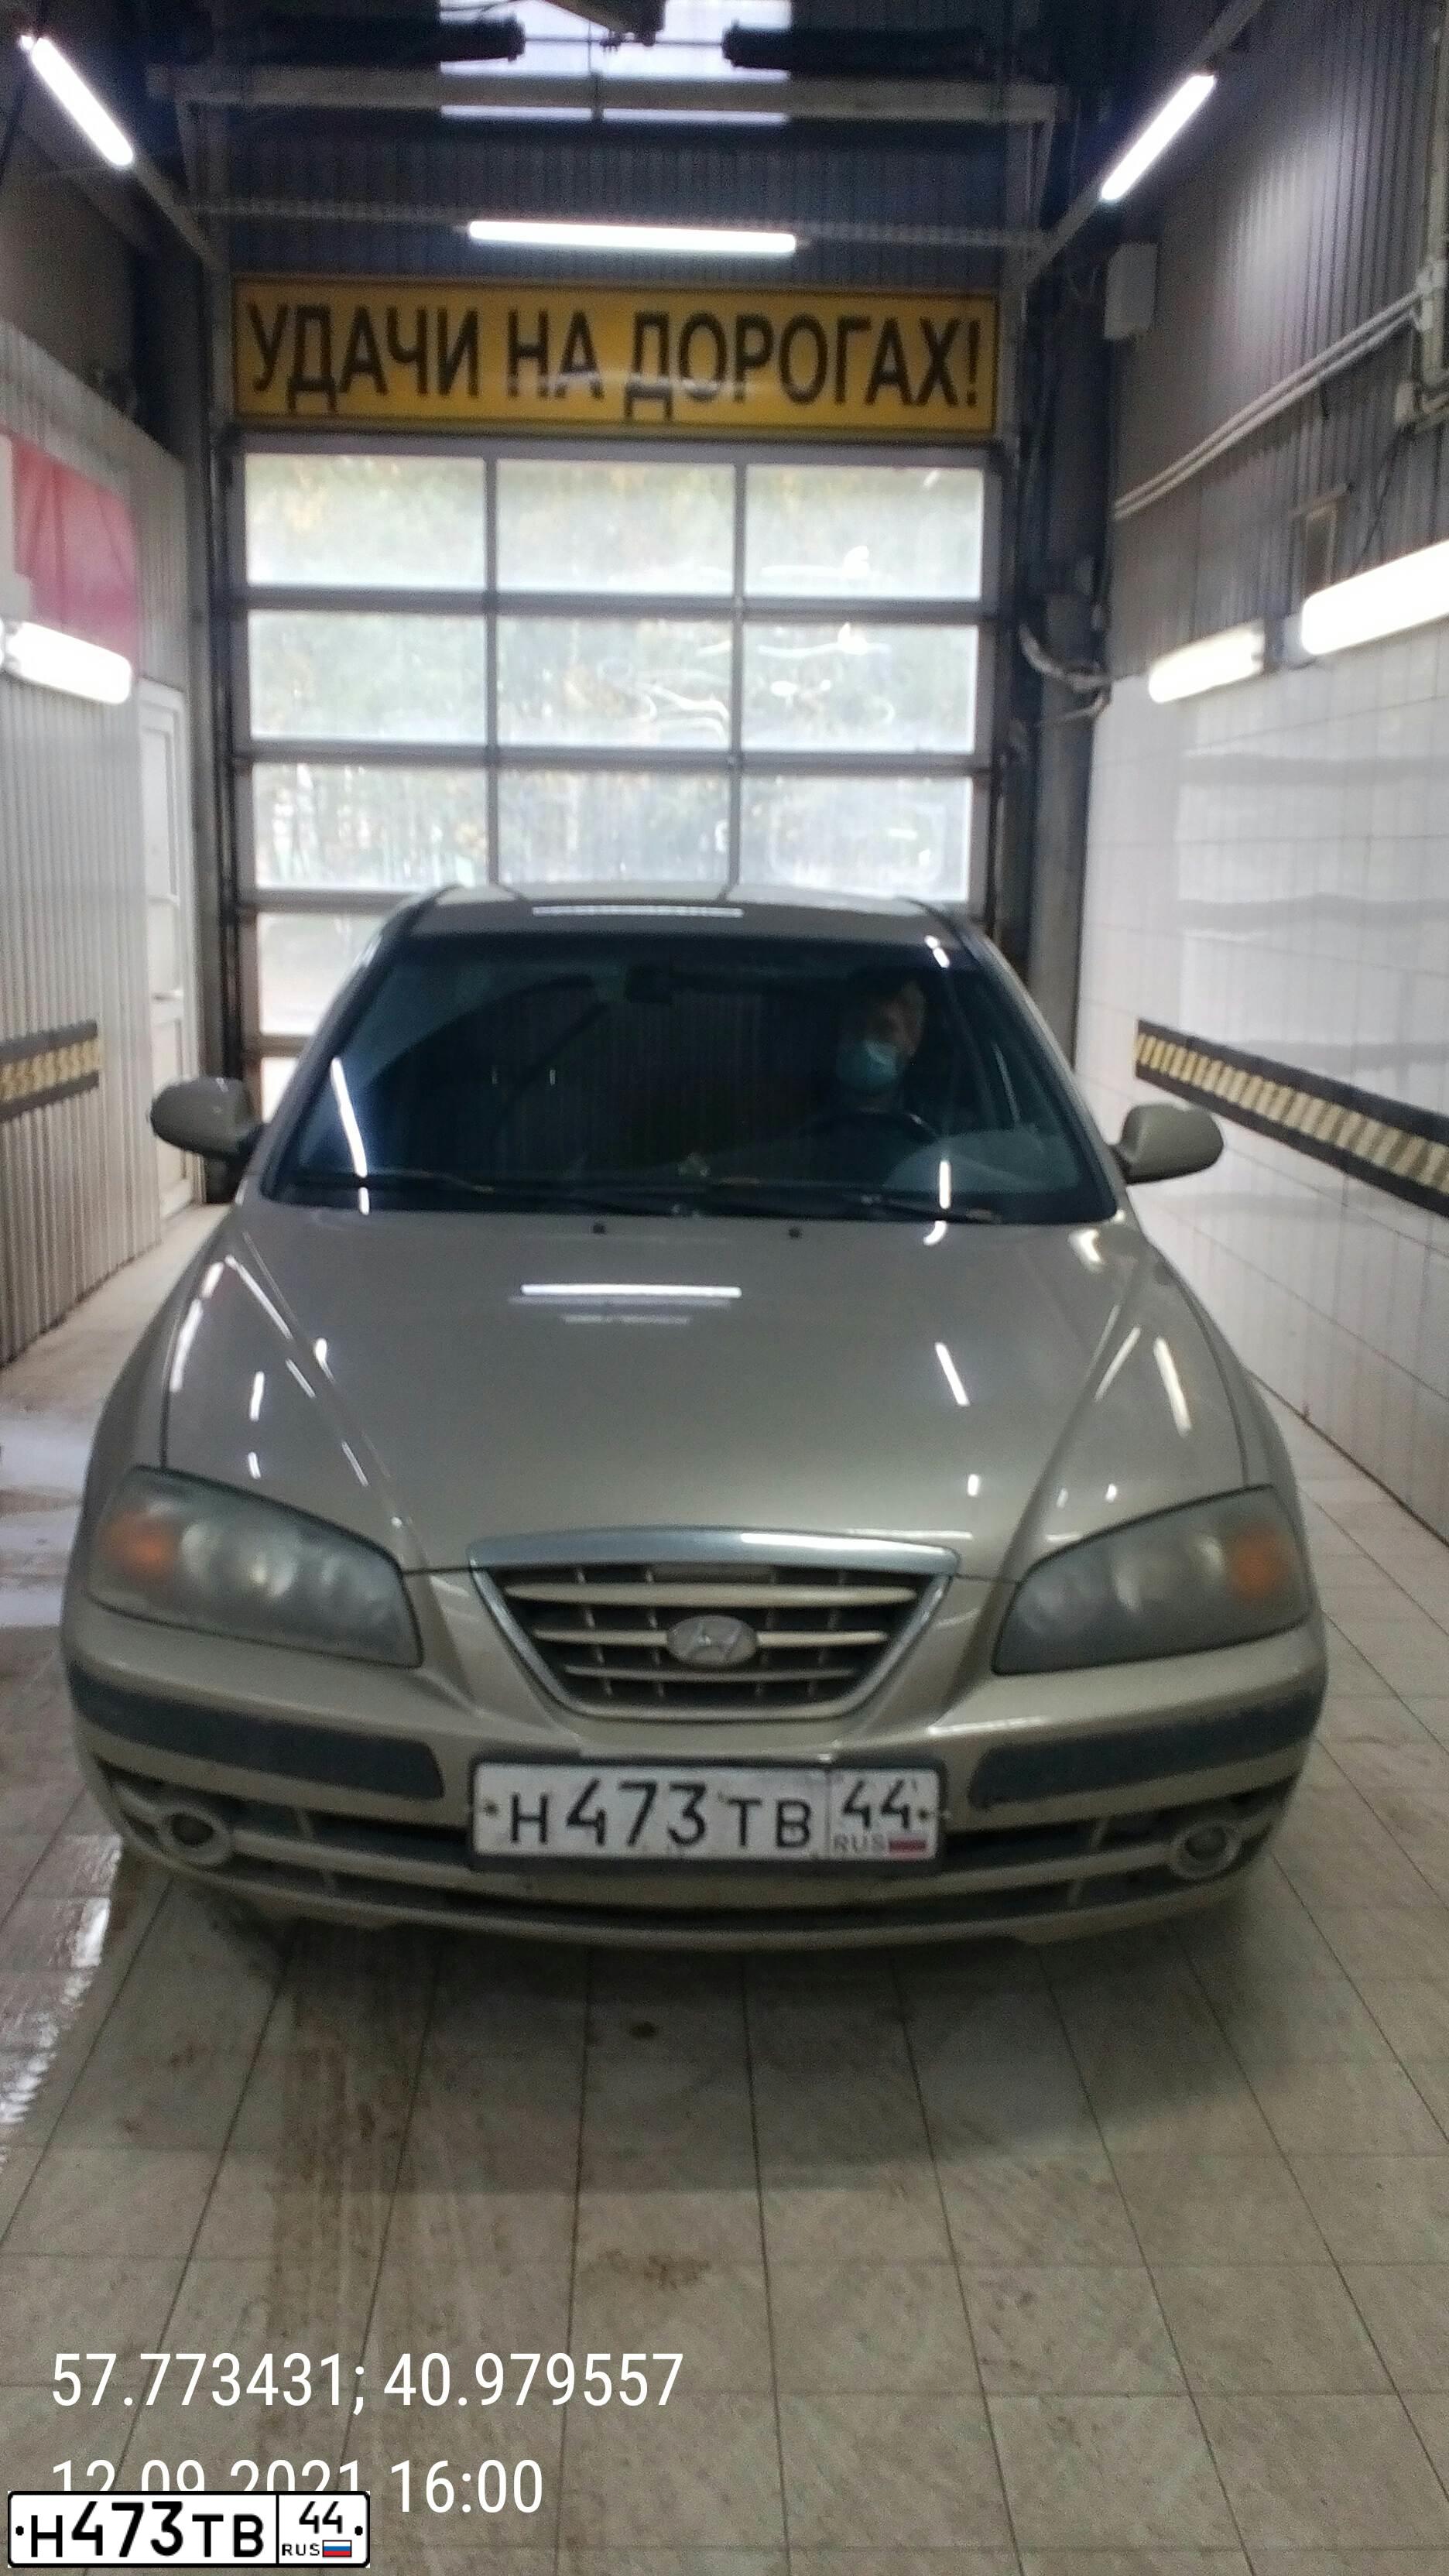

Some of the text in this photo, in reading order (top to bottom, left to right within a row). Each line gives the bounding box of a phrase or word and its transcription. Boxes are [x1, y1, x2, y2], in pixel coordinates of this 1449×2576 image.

[249, 303, 982, 421] УДАЧИ НА ДОРОГАХ!
[841, 1780, 912, 1830] 44
[833, 1834, 886, 1852] RUS
